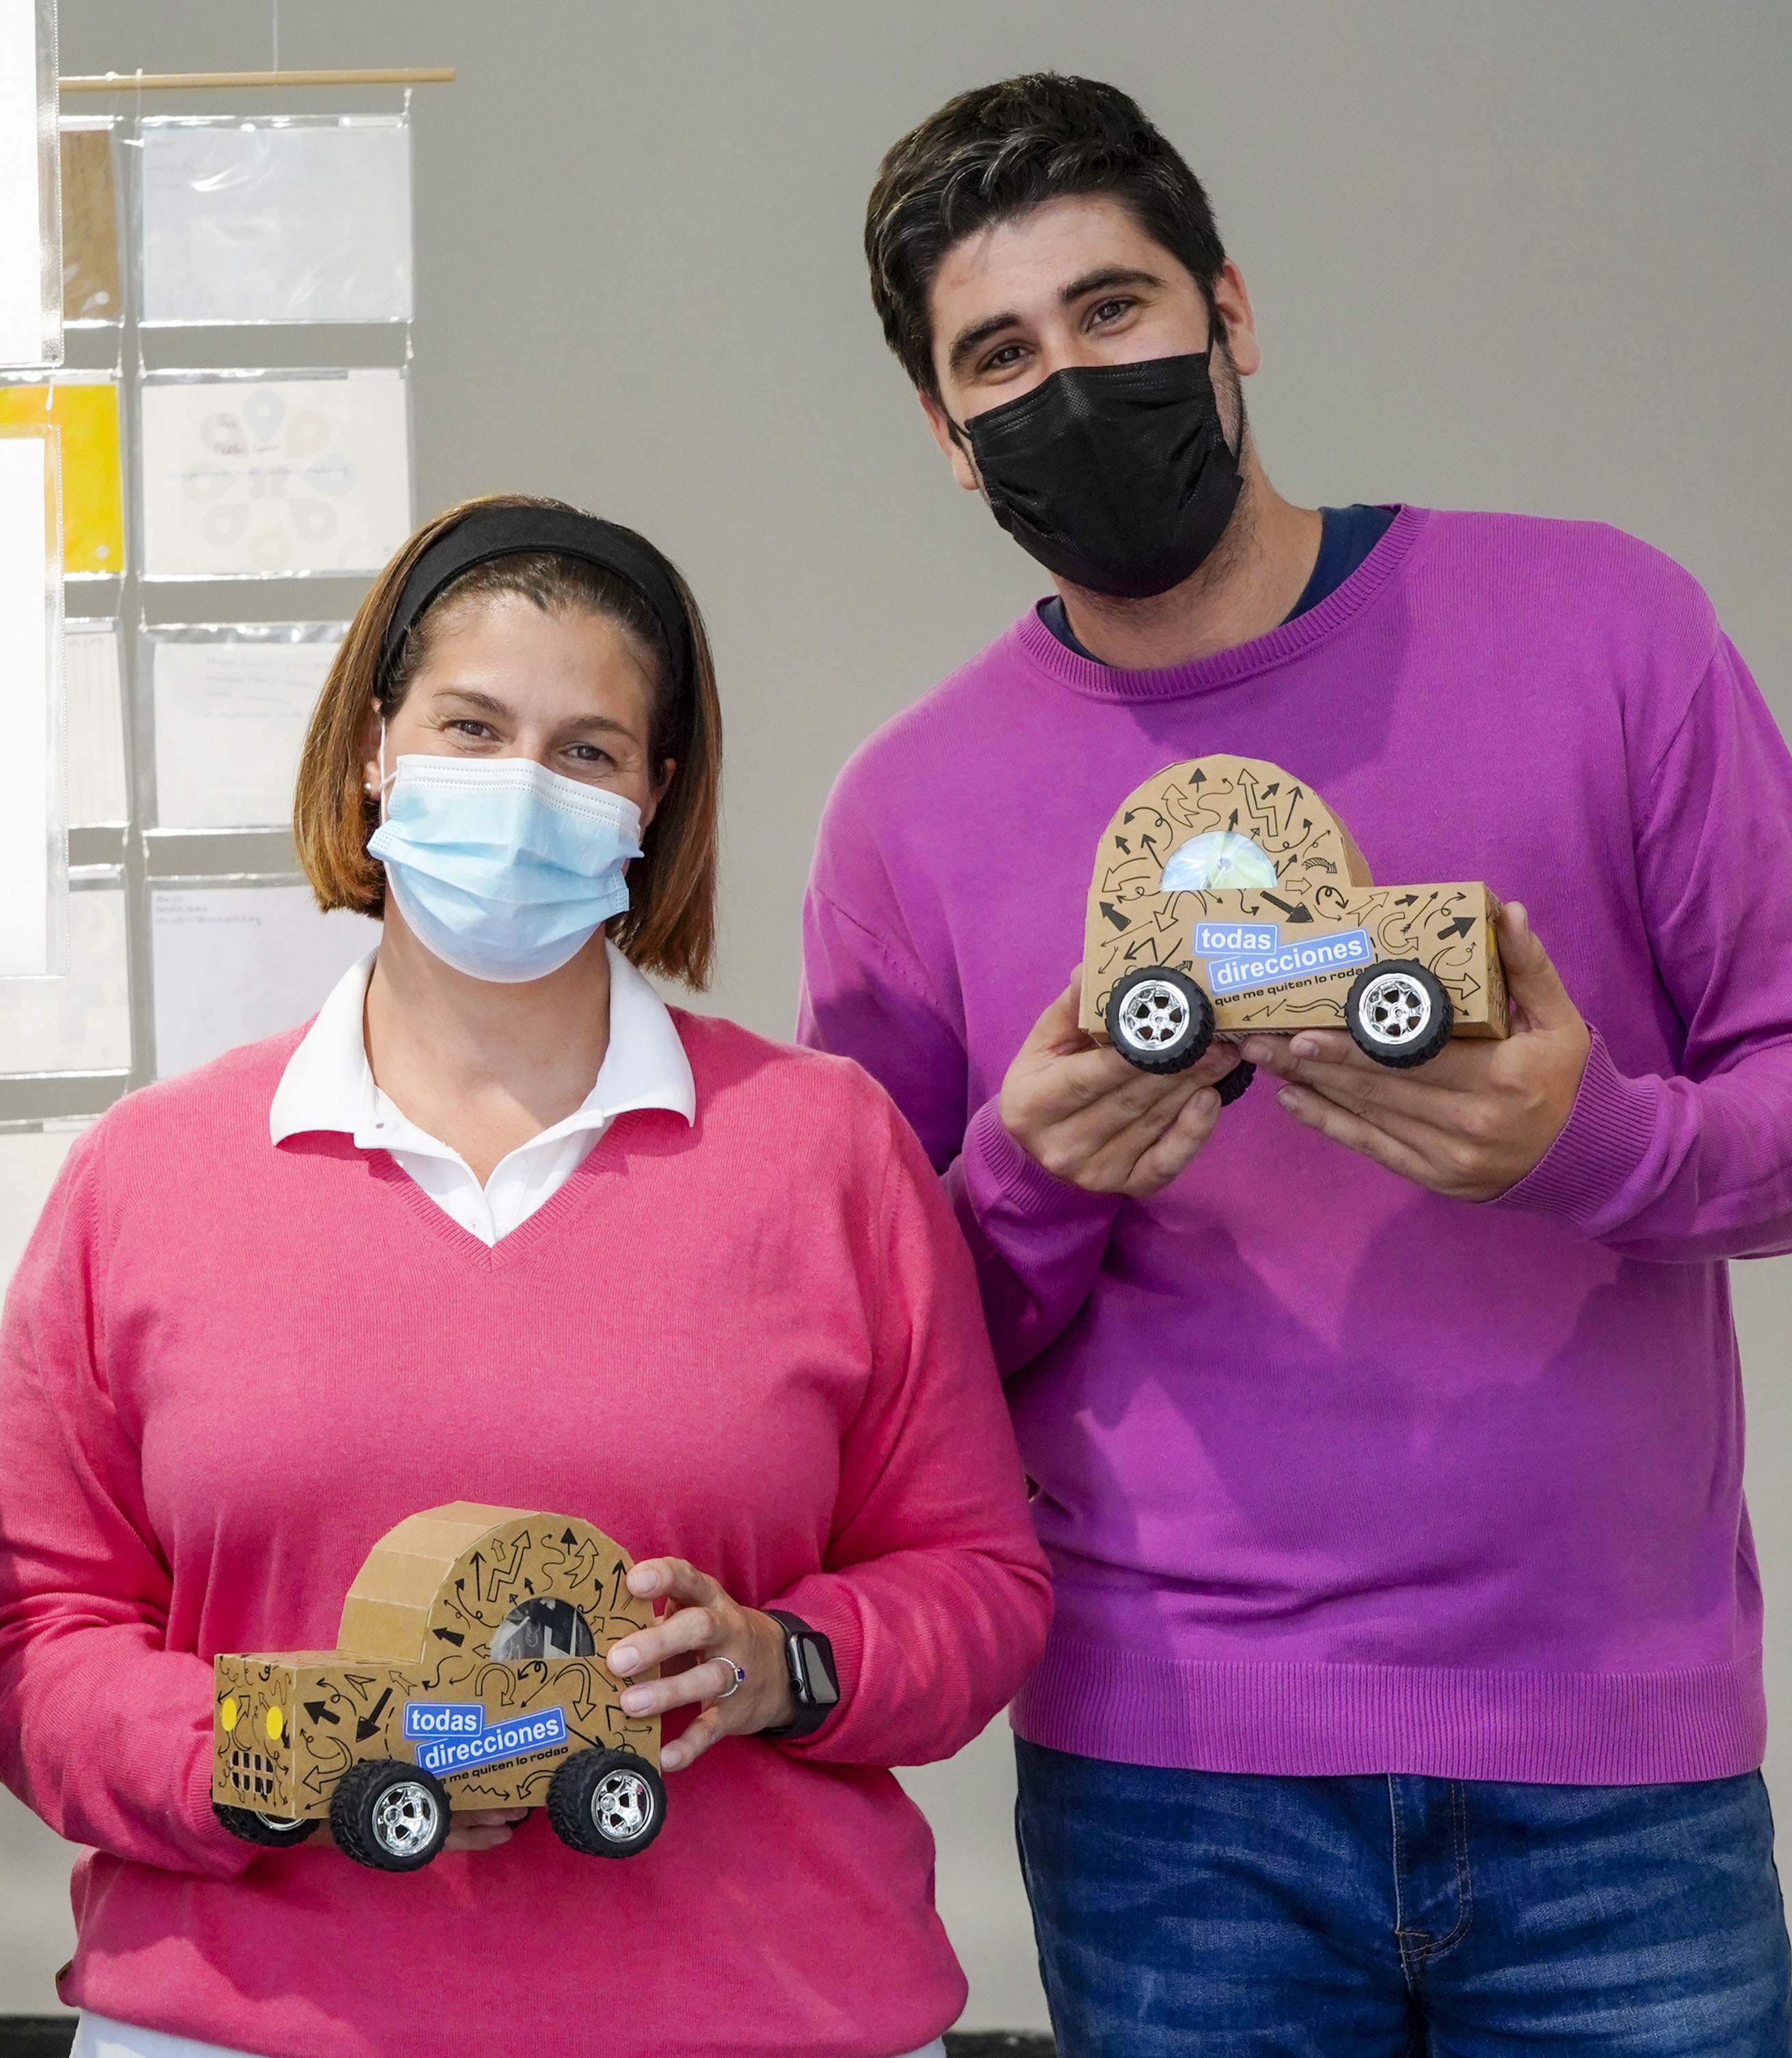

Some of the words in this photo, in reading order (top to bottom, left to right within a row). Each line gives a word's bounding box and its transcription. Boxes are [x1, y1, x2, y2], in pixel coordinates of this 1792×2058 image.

[1201, 928, 1272, 949] todas
[1217, 939, 1363, 985] direcciones
[1214, 994, 1240, 1006] que
[1243, 989, 1265, 1000] me
[1267, 978, 1313, 995] quiten
[1315, 975, 1327, 984] lo
[1330, 967, 1363, 981] roda
[411, 1709, 477, 1732] todas
[425, 1719, 559, 1769] direcciones
[449, 1772, 469, 1783] me
[472, 1760, 514, 1778] quiten
[516, 1757, 528, 1766] lo
[531, 1747, 569, 1762] rodao
